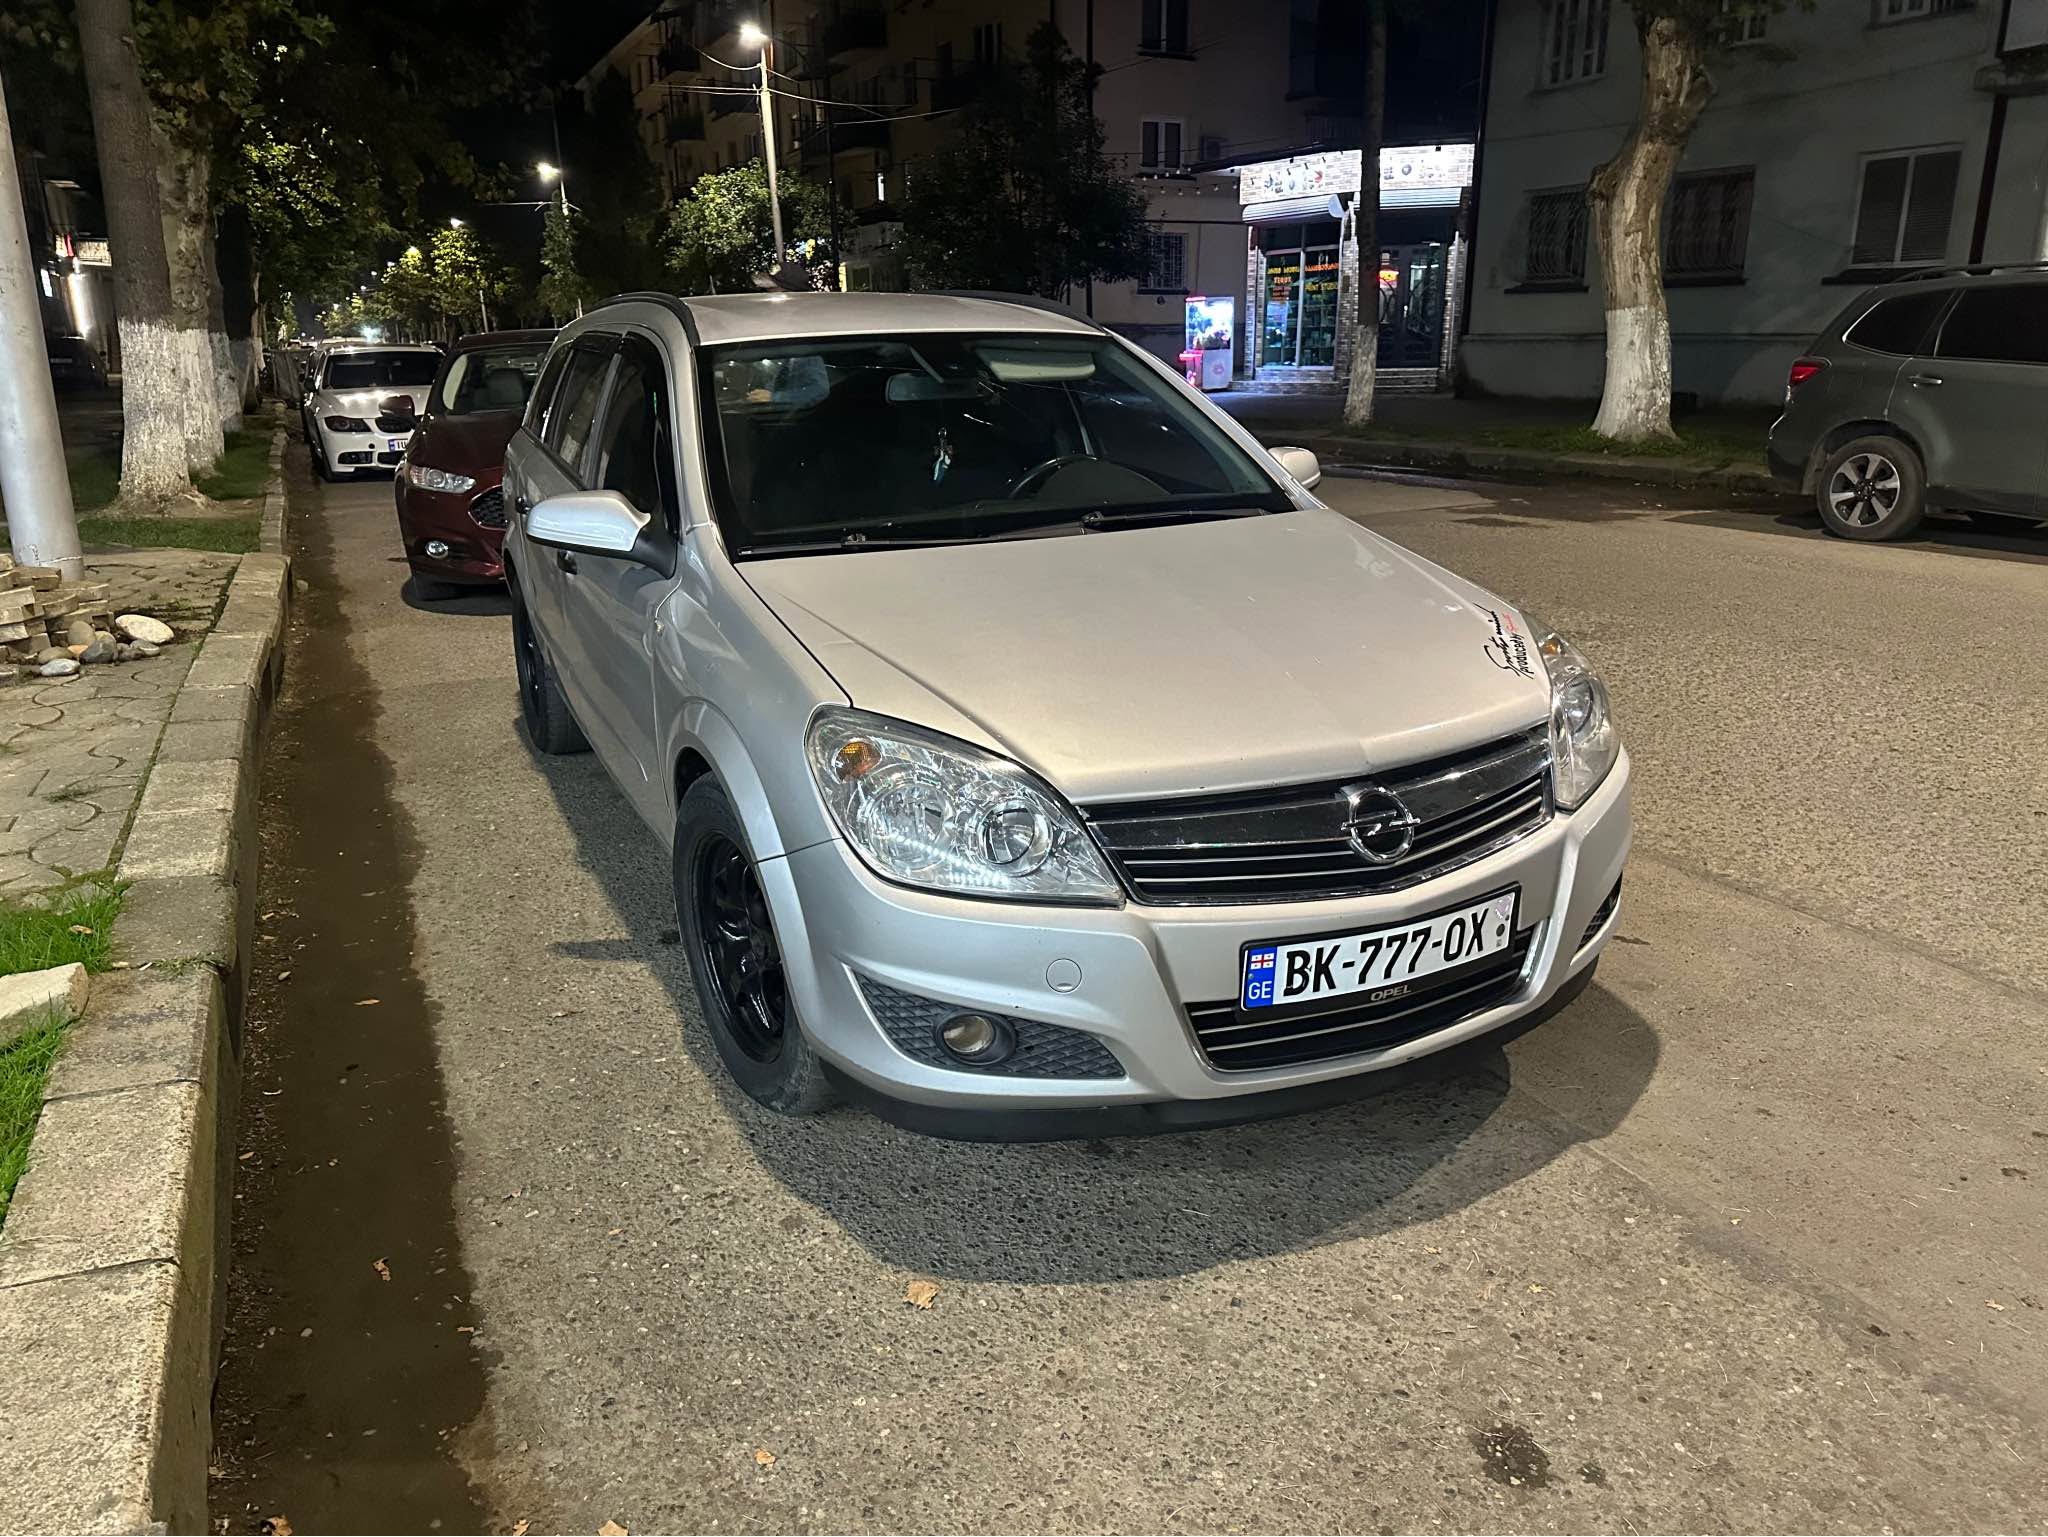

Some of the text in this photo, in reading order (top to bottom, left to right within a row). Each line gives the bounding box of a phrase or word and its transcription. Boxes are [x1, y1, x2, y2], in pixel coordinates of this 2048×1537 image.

[1283, 907, 1490, 998] BK-777-OX
[1248, 980, 1273, 1000] GE
[1370, 984, 1412, 1002] OPEL
